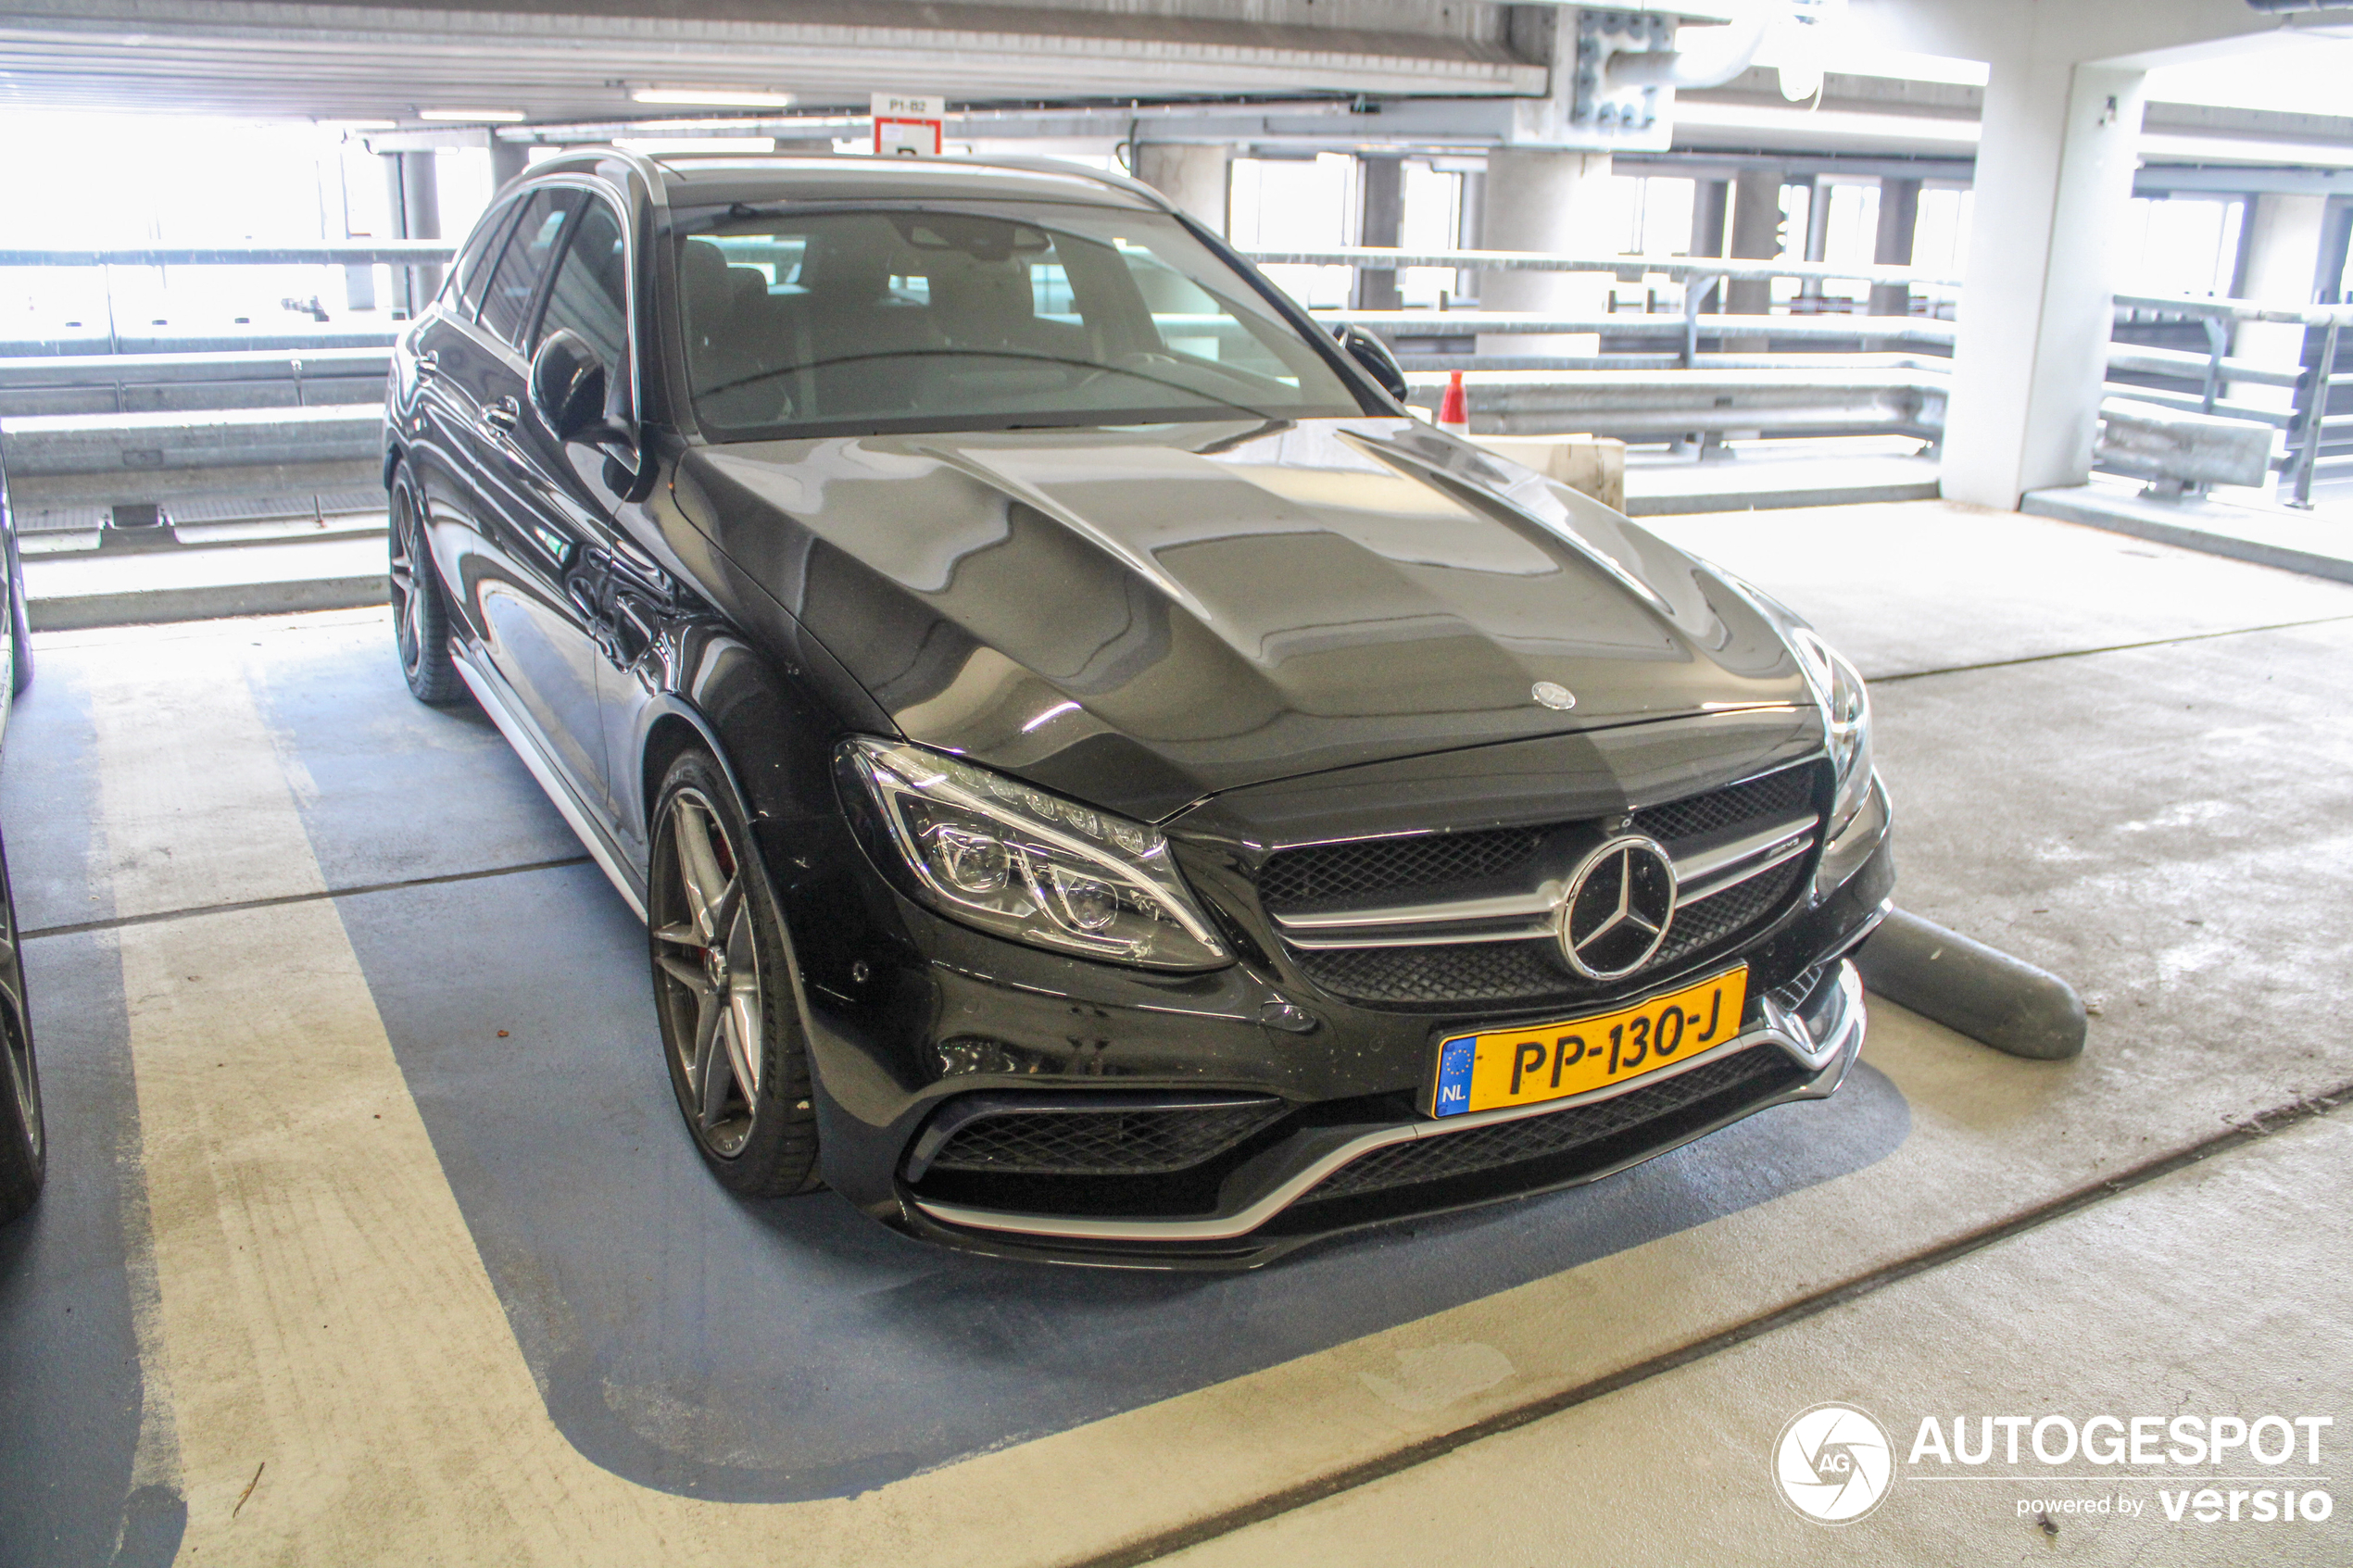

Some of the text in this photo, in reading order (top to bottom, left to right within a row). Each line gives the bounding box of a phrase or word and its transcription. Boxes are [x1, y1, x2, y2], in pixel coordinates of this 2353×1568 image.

[890, 99, 926, 112] P1-B2
[1510, 988, 1721, 1095] PP-130-J
[1441, 1085, 1466, 1103] NL
